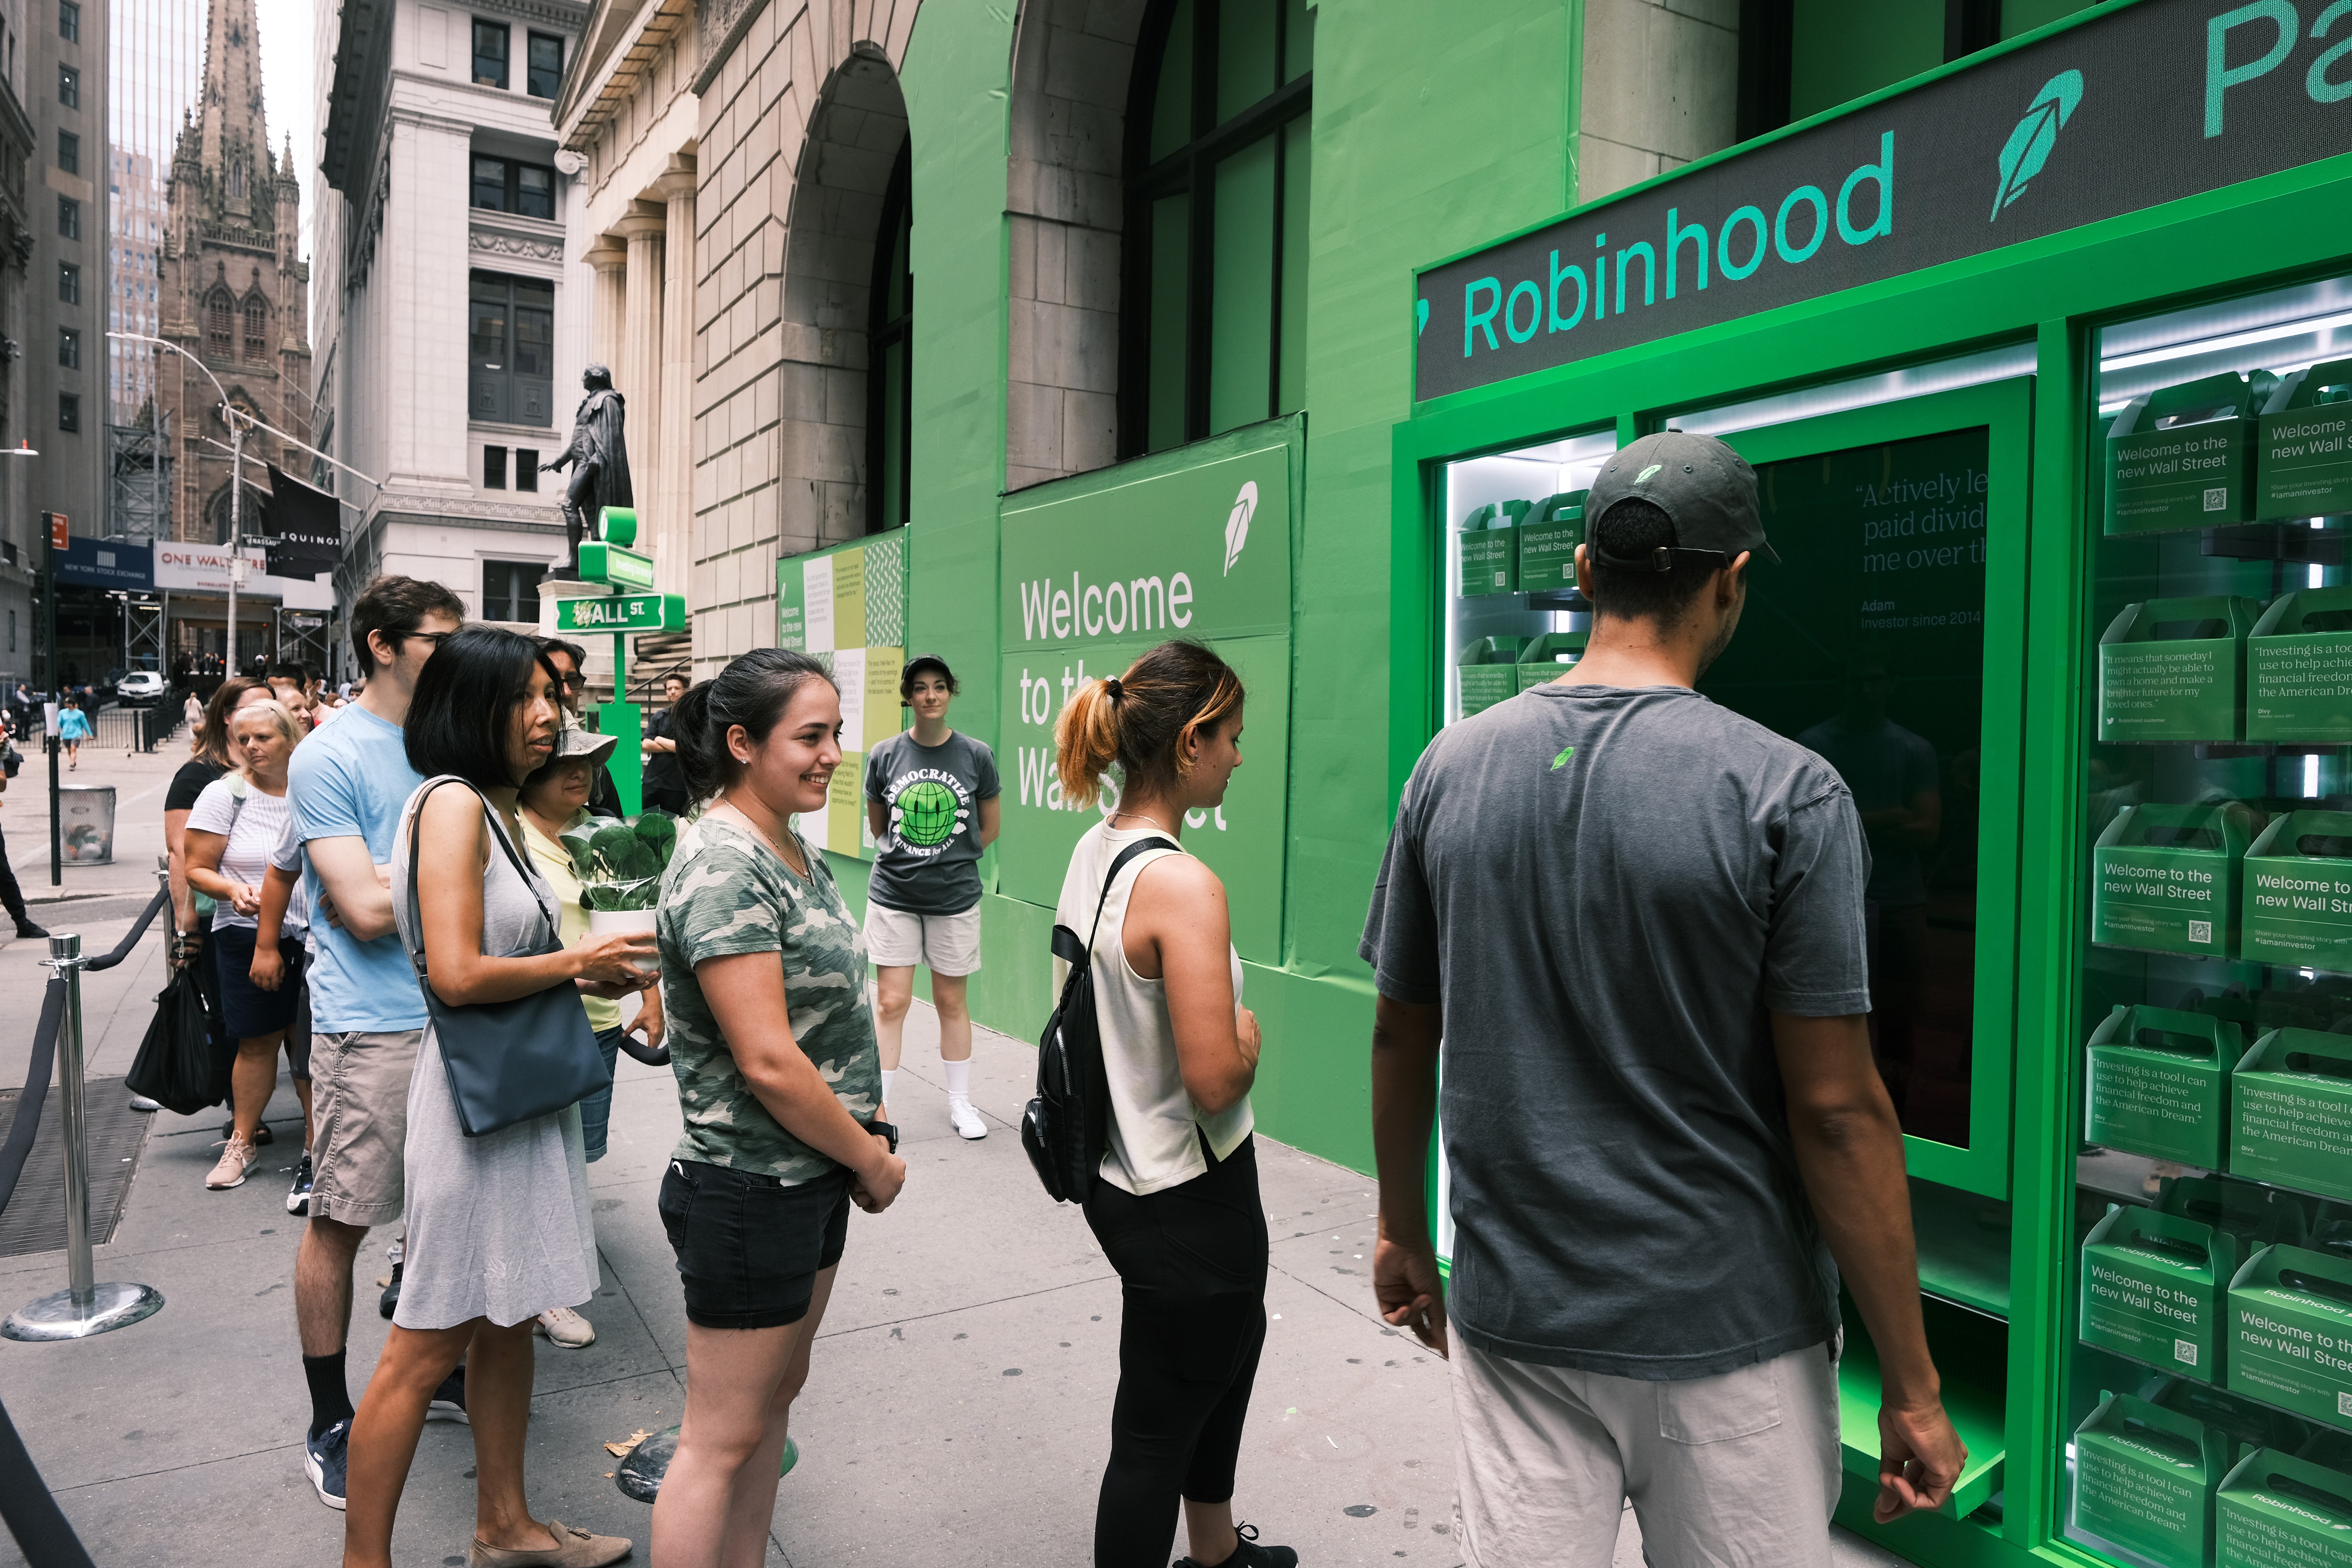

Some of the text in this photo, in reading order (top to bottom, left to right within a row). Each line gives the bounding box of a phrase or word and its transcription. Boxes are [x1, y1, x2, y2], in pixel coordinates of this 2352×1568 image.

[1465, 130, 1894, 357] Robinhood
[2273, 420, 2346, 440] Welcome
[2118, 437, 2227, 461] Welcome to the
[2272, 445, 2304, 459] new
[2309, 436, 2342, 453] Wall
[2118, 454, 2226, 479] new Wall Street
[2272, 487, 2332, 498] #iamaninvestor
[2117, 506, 2168, 515] #iamaninvestor
[1864, 502, 1984, 546] paid divid
[253, 537, 276, 546] NASSAU
[281, 532, 340, 546] EQUINOX
[1524, 533, 1553, 542] Welcome
[1539, 544, 1551, 552] Wall
[1553, 541, 1573, 551] Street
[161, 552, 190, 565] ONE
[1864, 553, 1900, 572] me
[1907, 546, 1963, 569] over
[80, 565, 95, 574] YORK
[96, 567, 115, 576] STOCK
[116, 570, 145, 579] EXCHANGE
[573, 602, 645, 624] WALL ST.
[782, 606, 799, 618] Welcome
[1021, 571, 1193, 640] Welcome
[1861, 600, 1895, 612] Adam
[1862, 611, 1981, 629] Investor since 2014
[2165, 652, 2207, 662] someday
[2255, 645, 2310, 657] “Investing
[2314, 645, 2323, 654] is
[2108, 666, 2131, 676] might
[2133, 665, 2167, 675] actually
[2182, 663, 2202, 672] able
[2282, 661, 2292, 669] to
[2295, 658, 2320, 671] help
[2161, 675, 2177, 684] and
[2180, 675, 2205, 684] make
[2259, 673, 2305, 683] financial
[1020, 669, 1050, 725] to
[2107, 689, 2140, 699] brighter
[2171, 687, 2183, 696] for
[2185, 689, 2199, 697] my
[2259, 688, 2276, 697] the
[2279, 686, 2334, 696] American
[2107, 698, 2158, 708] loved ones.”
[887, 768, 970, 806] DEMOCRATIZE
[1018, 747, 1083, 813] Wa
[894, 835, 954, 856] FINANCE for ALL
[2105, 863, 2212, 883] Welcome to the
[2105, 882, 2211, 900] new Wall Street
[2257, 874, 2350, 894] Welcome to
[2257, 895, 2288, 907] new
[2293, 896, 2326, 911] Wall
[2256, 937, 2315, 949] #iamaninvestor
[2093, 1058, 2140, 1076] “Investing
[2142, 1067, 2150, 1076] is
[2160, 1071, 2179, 1082] tool
[2182, 1074, 2185, 1083] I
[2187, 1077, 2206, 1087] can
[2097, 1073, 2188, 1096] use to help achieve
[2096, 1083, 2200, 1112] financial freedom and
[2096, 1096, 2201, 1124] the American Dream.”
[2115, 1245, 2184, 1266] Robinhood
[2264, 1289, 2344, 1314] Robinhood
[2241, 1310, 2312, 1342] Welcome
[2317, 1333, 2333, 1348] to
[2242, 1331, 2272, 1348] new
[2277, 1339, 2309, 1360] Wall
[2241, 1371, 2299, 1395] #iamaninvestor
[2109, 1435, 2177, 1463] Robinhood
[2252, 1493, 2332, 1525] Robinhood
